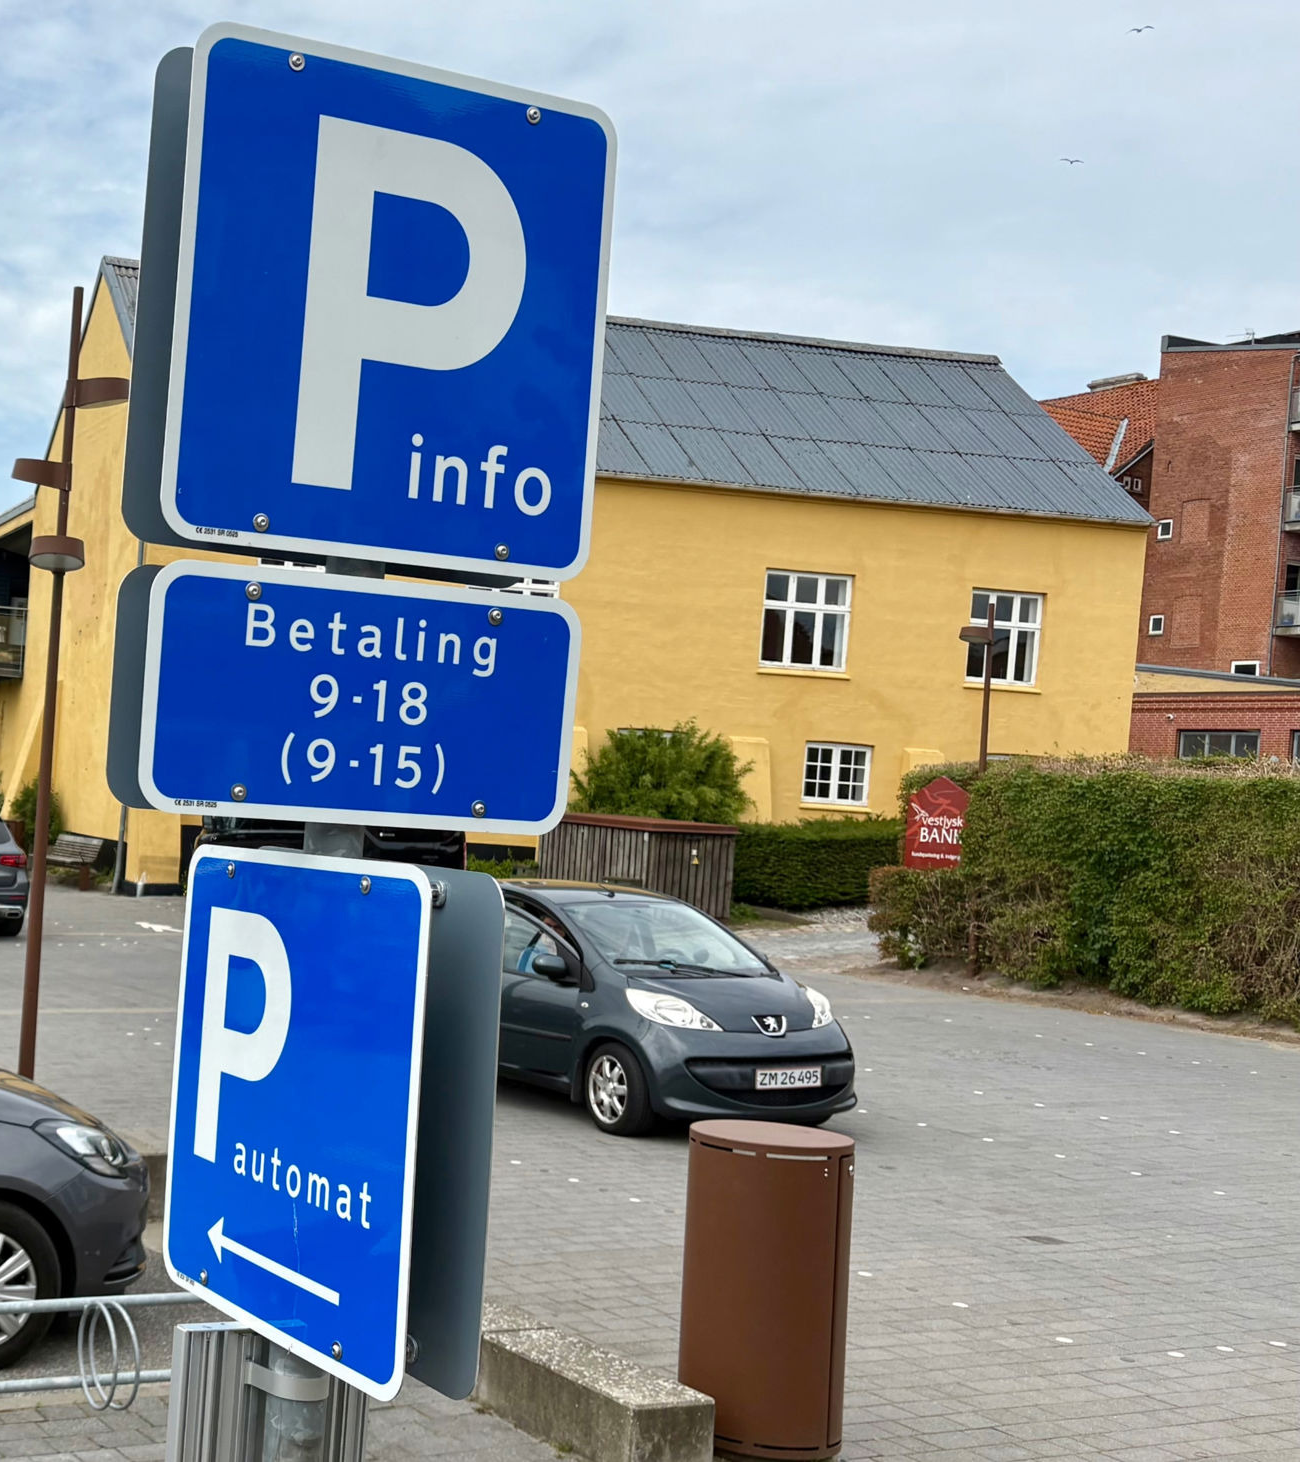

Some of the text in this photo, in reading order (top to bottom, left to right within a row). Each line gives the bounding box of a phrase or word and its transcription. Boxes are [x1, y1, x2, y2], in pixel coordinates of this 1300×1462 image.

[292, 115, 526, 490] P
[409, 434, 552, 516] info
[246, 603, 497, 678] Betaling
[310, 673, 428, 726] 9-18
[281, 733, 445, 794] (9-15)
[194, 907, 292, 1164] P
[759, 1070, 819, 1086] ZM 26 495
[234, 1143, 372, 1230] automat
